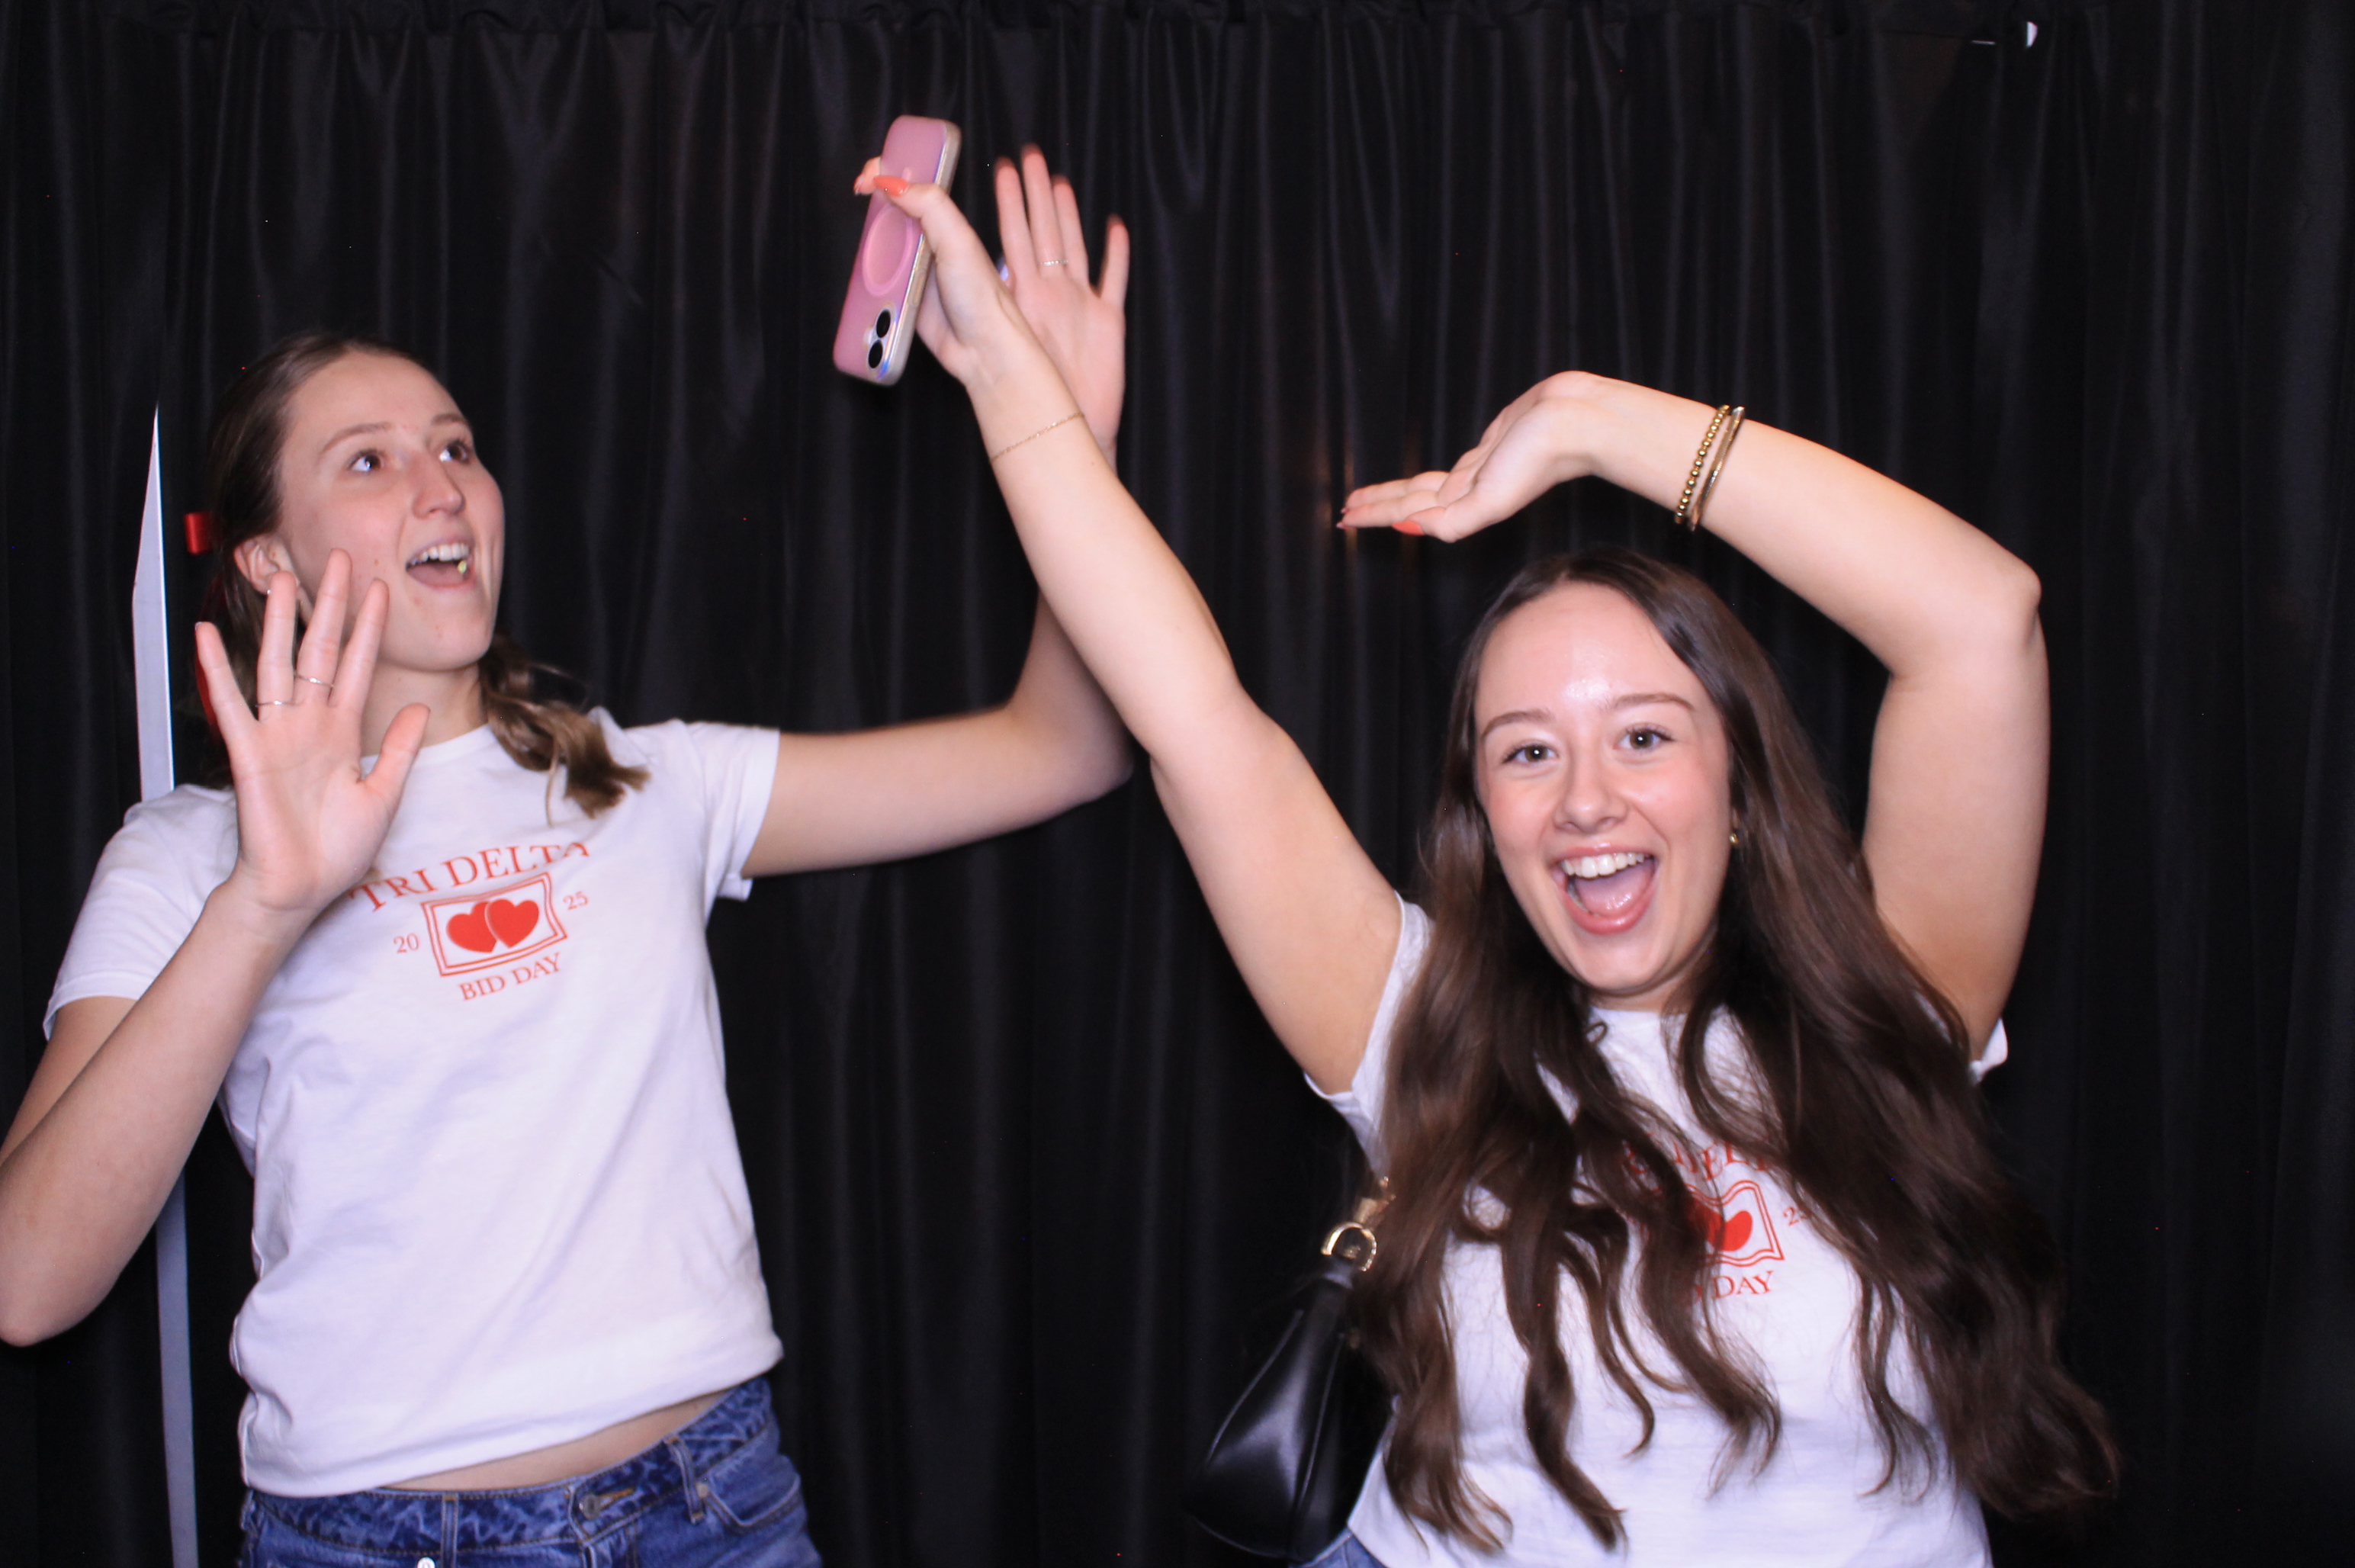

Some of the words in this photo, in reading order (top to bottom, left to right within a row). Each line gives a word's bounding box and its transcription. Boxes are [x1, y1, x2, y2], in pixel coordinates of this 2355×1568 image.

[349, 869, 439, 912] TRI
[394, 933, 420, 953] 20
[562, 891, 590, 910] 25
[457, 975, 506, 1001] BID
[511, 952, 562, 985] DAY
[1711, 1270, 1775, 1300] DAY
